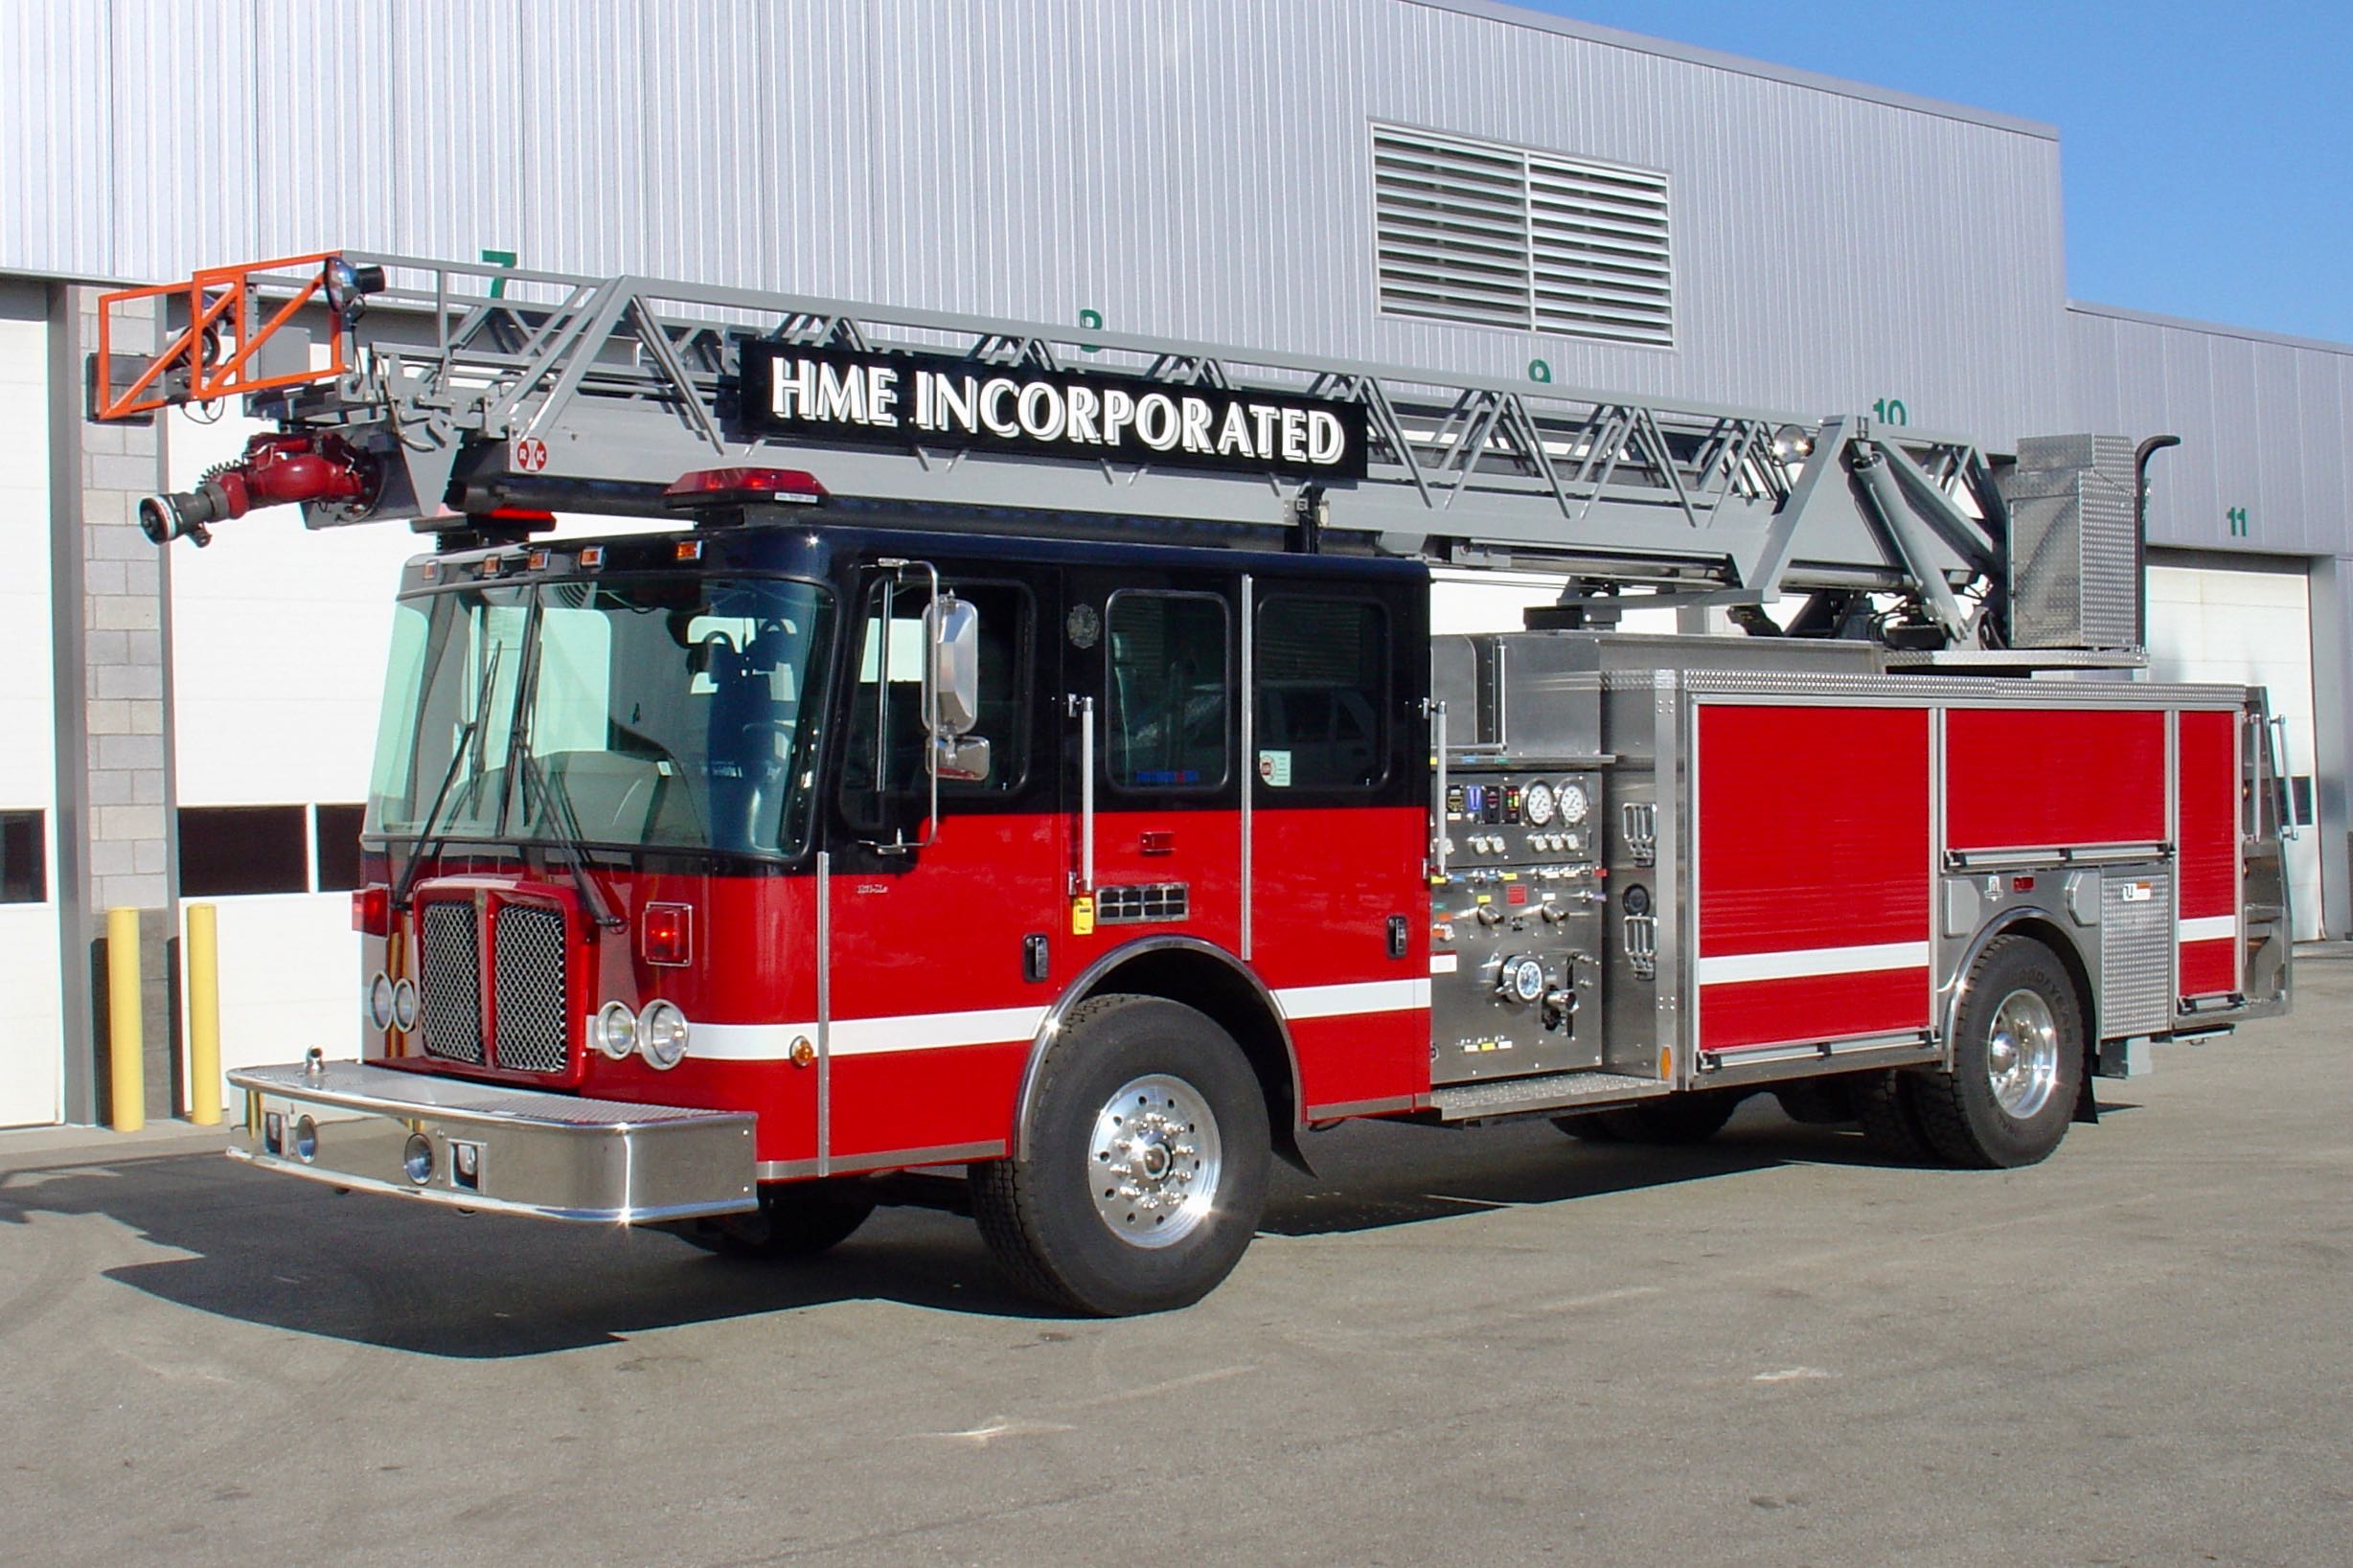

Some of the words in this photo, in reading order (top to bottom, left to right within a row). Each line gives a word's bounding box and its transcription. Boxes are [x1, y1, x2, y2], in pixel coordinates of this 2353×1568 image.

[482, 250, 517, 299] 7
[1528, 358, 1551, 383] 9
[772, 357, 898, 427] HME
[916, 371, 1345, 465] INCORPORATED
[1873, 398, 1906, 426] 10
[2227, 507, 2247, 536] 11
